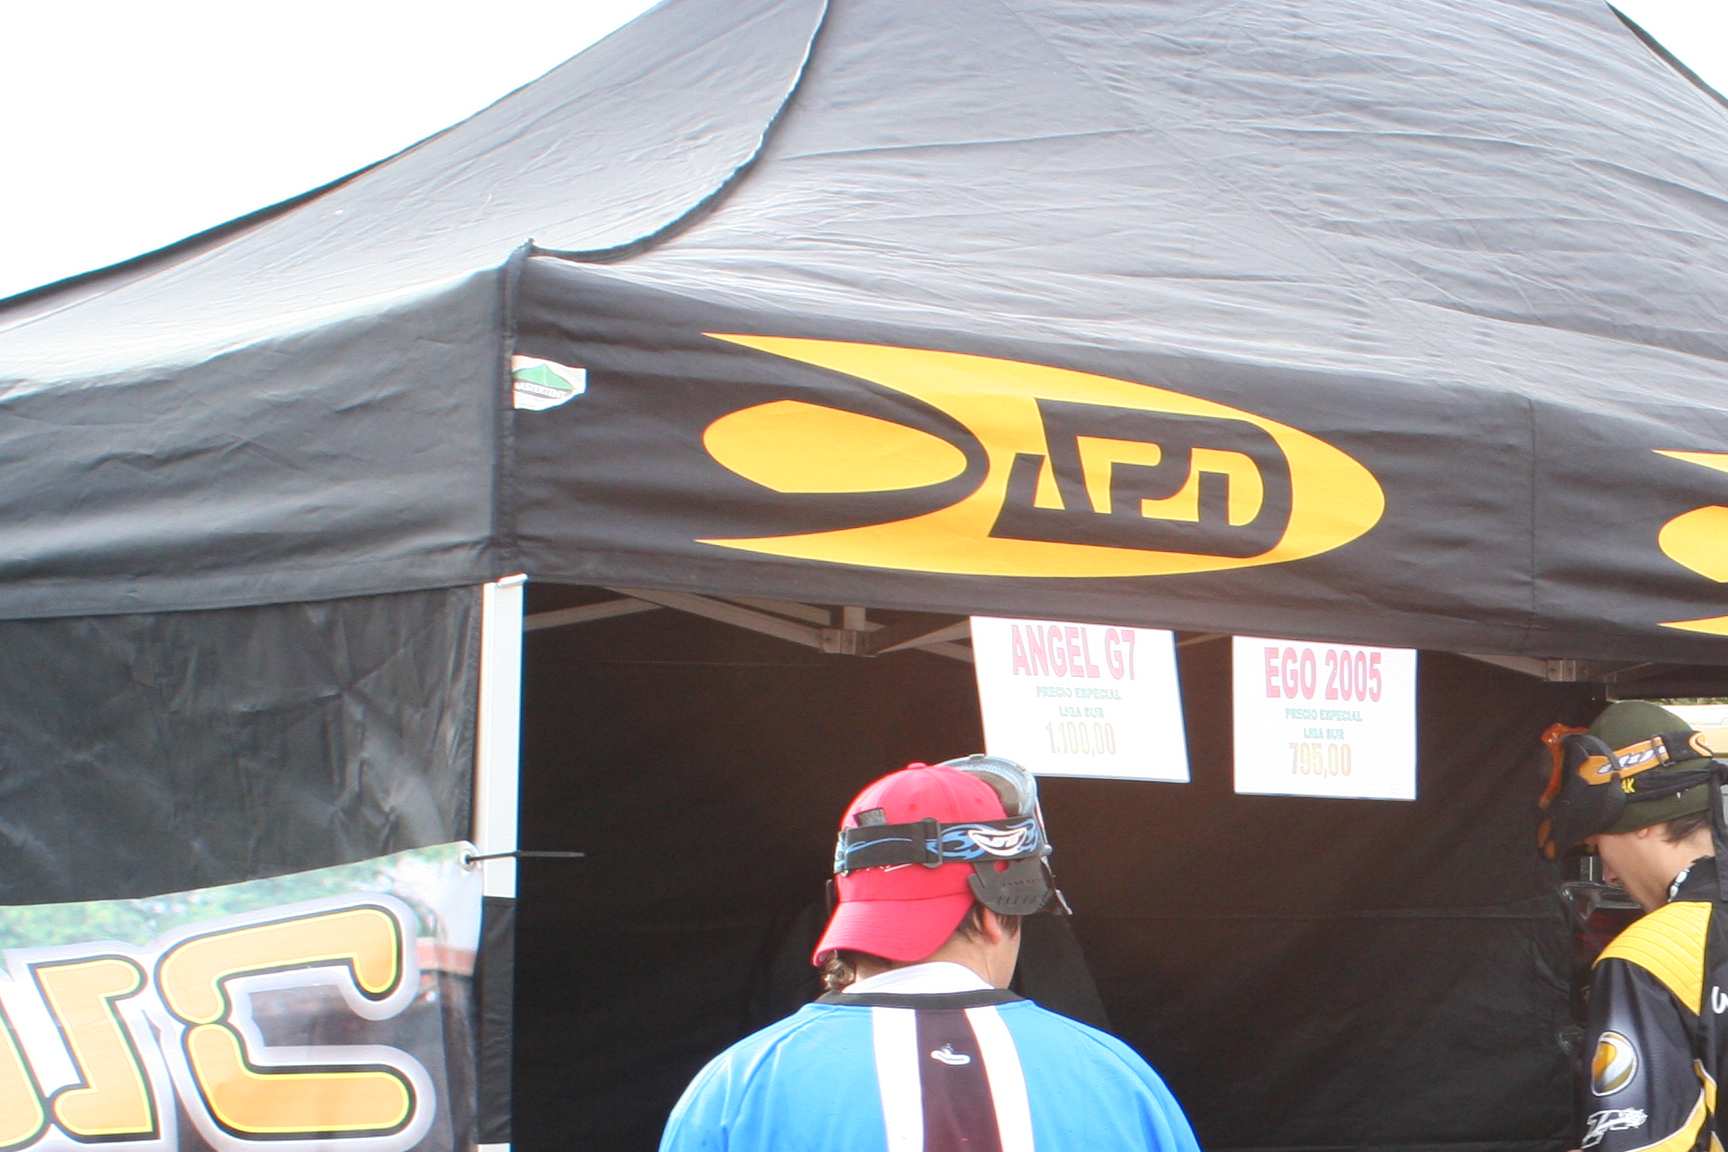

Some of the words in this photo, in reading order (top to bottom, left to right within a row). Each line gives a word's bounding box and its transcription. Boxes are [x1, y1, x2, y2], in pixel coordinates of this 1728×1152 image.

[1011, 624, 1101, 679] ANGEL
[1104, 627, 1136, 680] G7
[1264, 646, 1317, 700] EGO
[1324, 649, 1382, 702] 2005
[1036, 685, 1073, 698] PRECIO
[1075, 687, 1122, 700] ESPECIAL
[1059, 706, 1082, 717] LIGA
[1285, 708, 1318, 720] PRECIO
[1320, 709, 1362, 722] ESPECIAL
[1303, 727, 1325, 739] LIGA
[1326, 728, 1345, 740] SUR
[1289, 741, 1352, 778] 795,00
